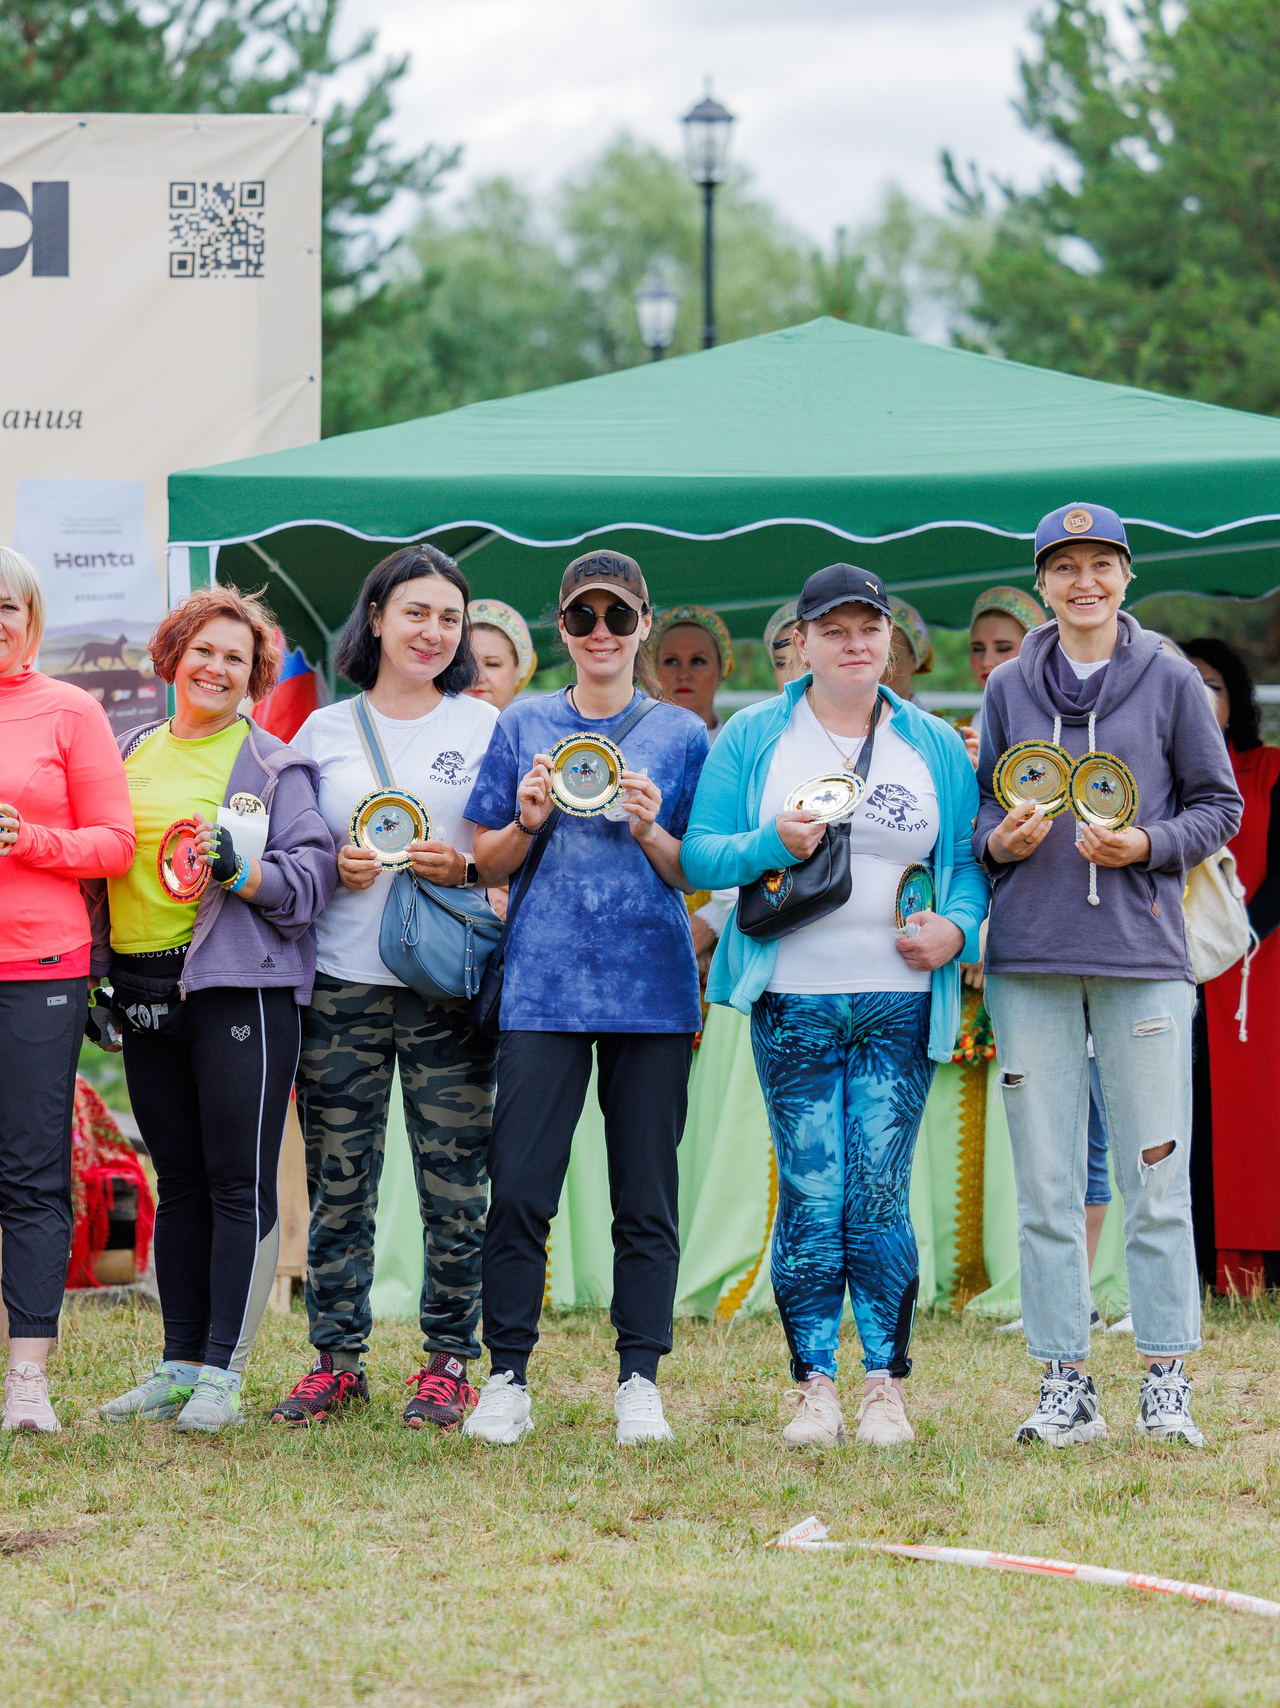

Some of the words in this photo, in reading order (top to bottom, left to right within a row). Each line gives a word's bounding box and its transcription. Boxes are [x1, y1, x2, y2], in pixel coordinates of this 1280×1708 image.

[54, 552, 134, 568] Hanta
[429, 774, 472, 786] ОЛЬБУРД
[865, 812, 929, 832] ОЛЬБУРД
